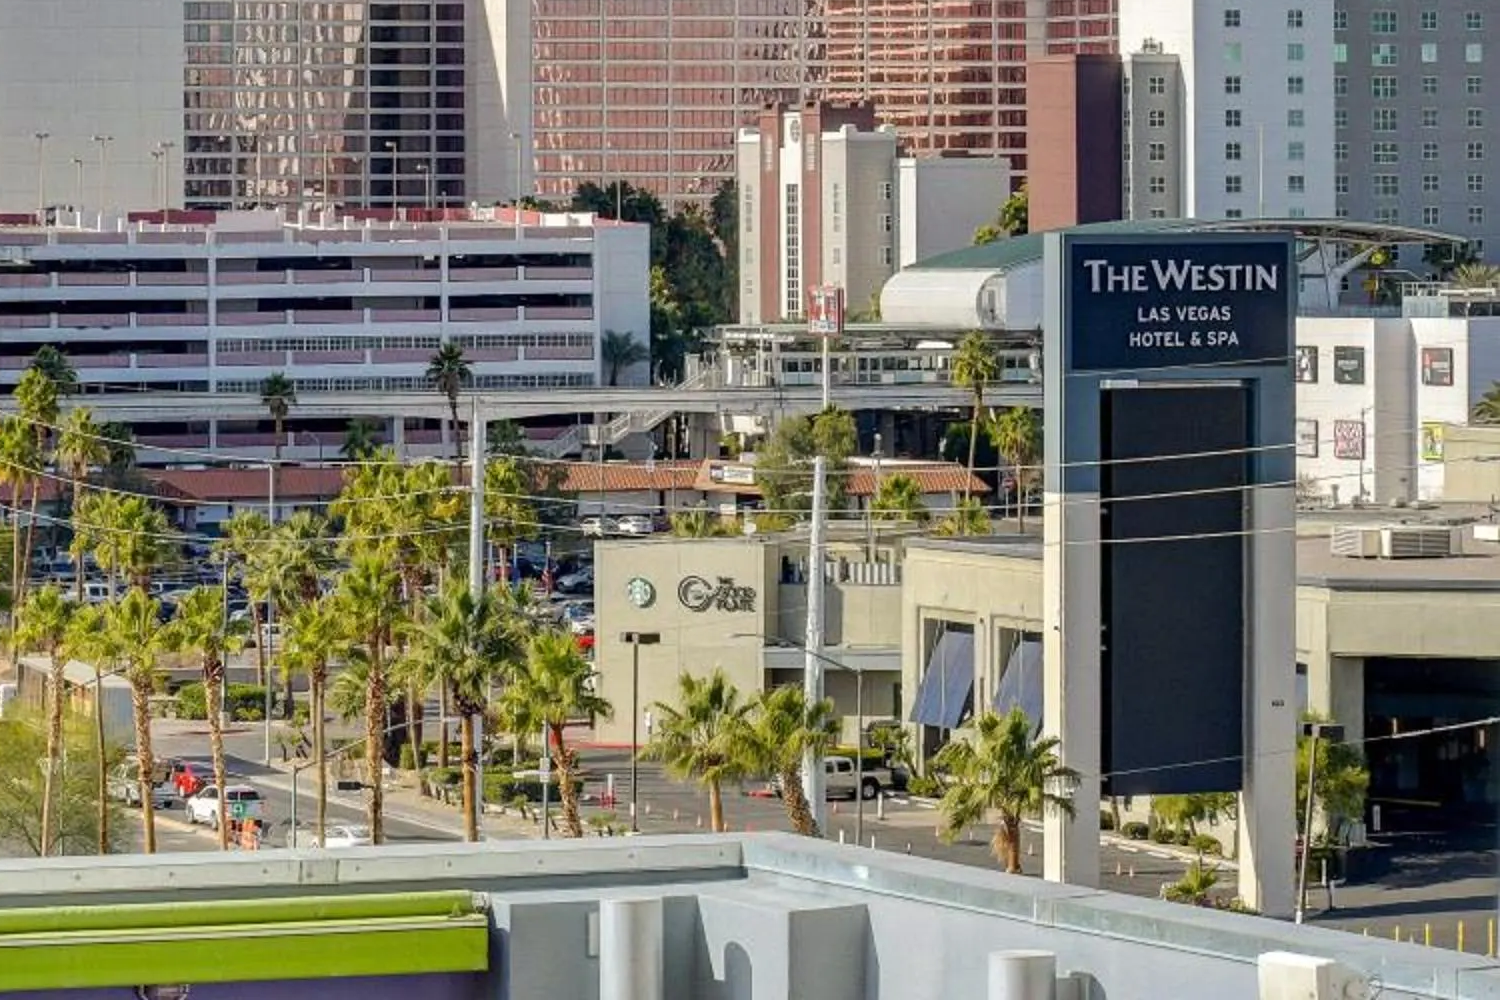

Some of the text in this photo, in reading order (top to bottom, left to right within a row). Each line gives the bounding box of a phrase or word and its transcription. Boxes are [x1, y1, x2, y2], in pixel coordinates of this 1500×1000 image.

[1084, 259, 1278, 293] THE WESTIN
[1137, 306, 1232, 322] LAS VEGAS
[1129, 331, 1239, 347] HOTEL & SPA
